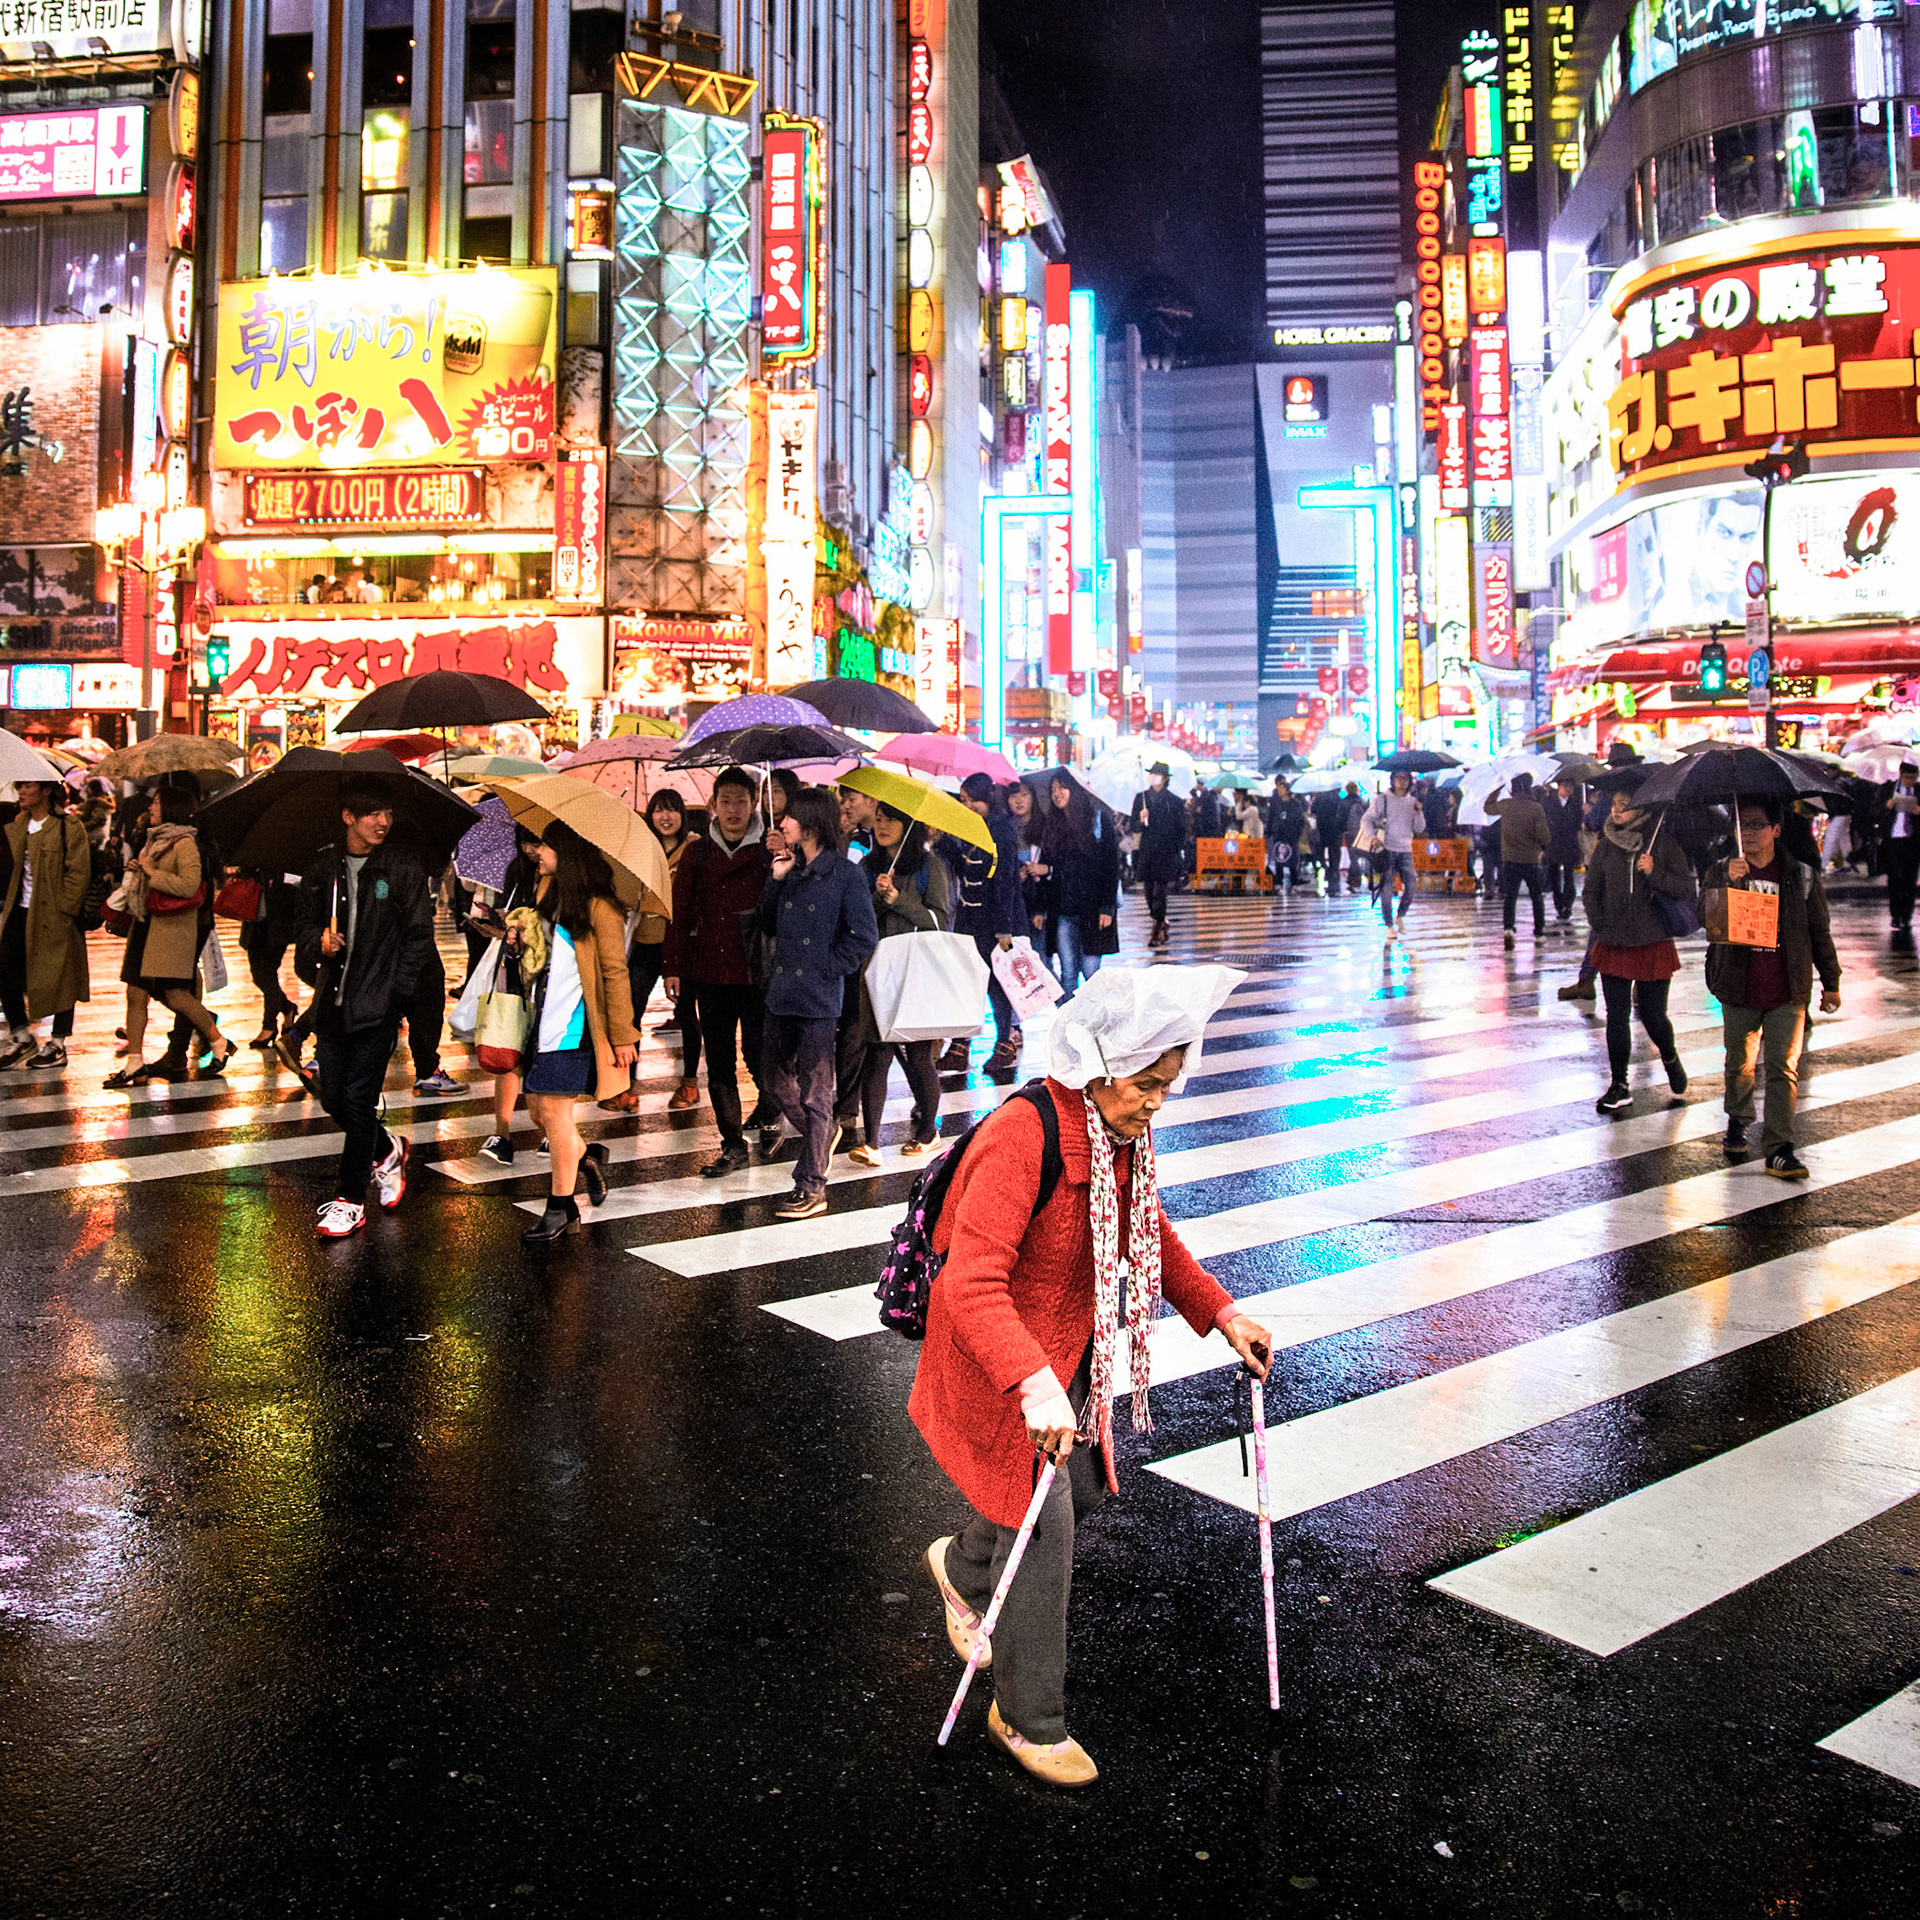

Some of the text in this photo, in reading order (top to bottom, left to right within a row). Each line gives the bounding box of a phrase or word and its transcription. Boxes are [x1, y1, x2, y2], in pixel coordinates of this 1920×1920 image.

[1722, 19, 1765, 37] PHOT
[104, 167, 134, 185] 1F
[231, 293, 436, 390] 朝から!
[445, 333, 481, 356] Asahi
[495, 393, 542, 404] スーパードライ
[227, 378, 453, 451] つぼ八
[482, 403, 548, 428] 生ビール
[251, 474, 469, 519] 放題2700円(2時間)
[1484, 555, 1511, 655] カラオケ
[617, 621, 753, 641] OKONOMI YAKI
[920, 627, 933, 690] トラノコ
